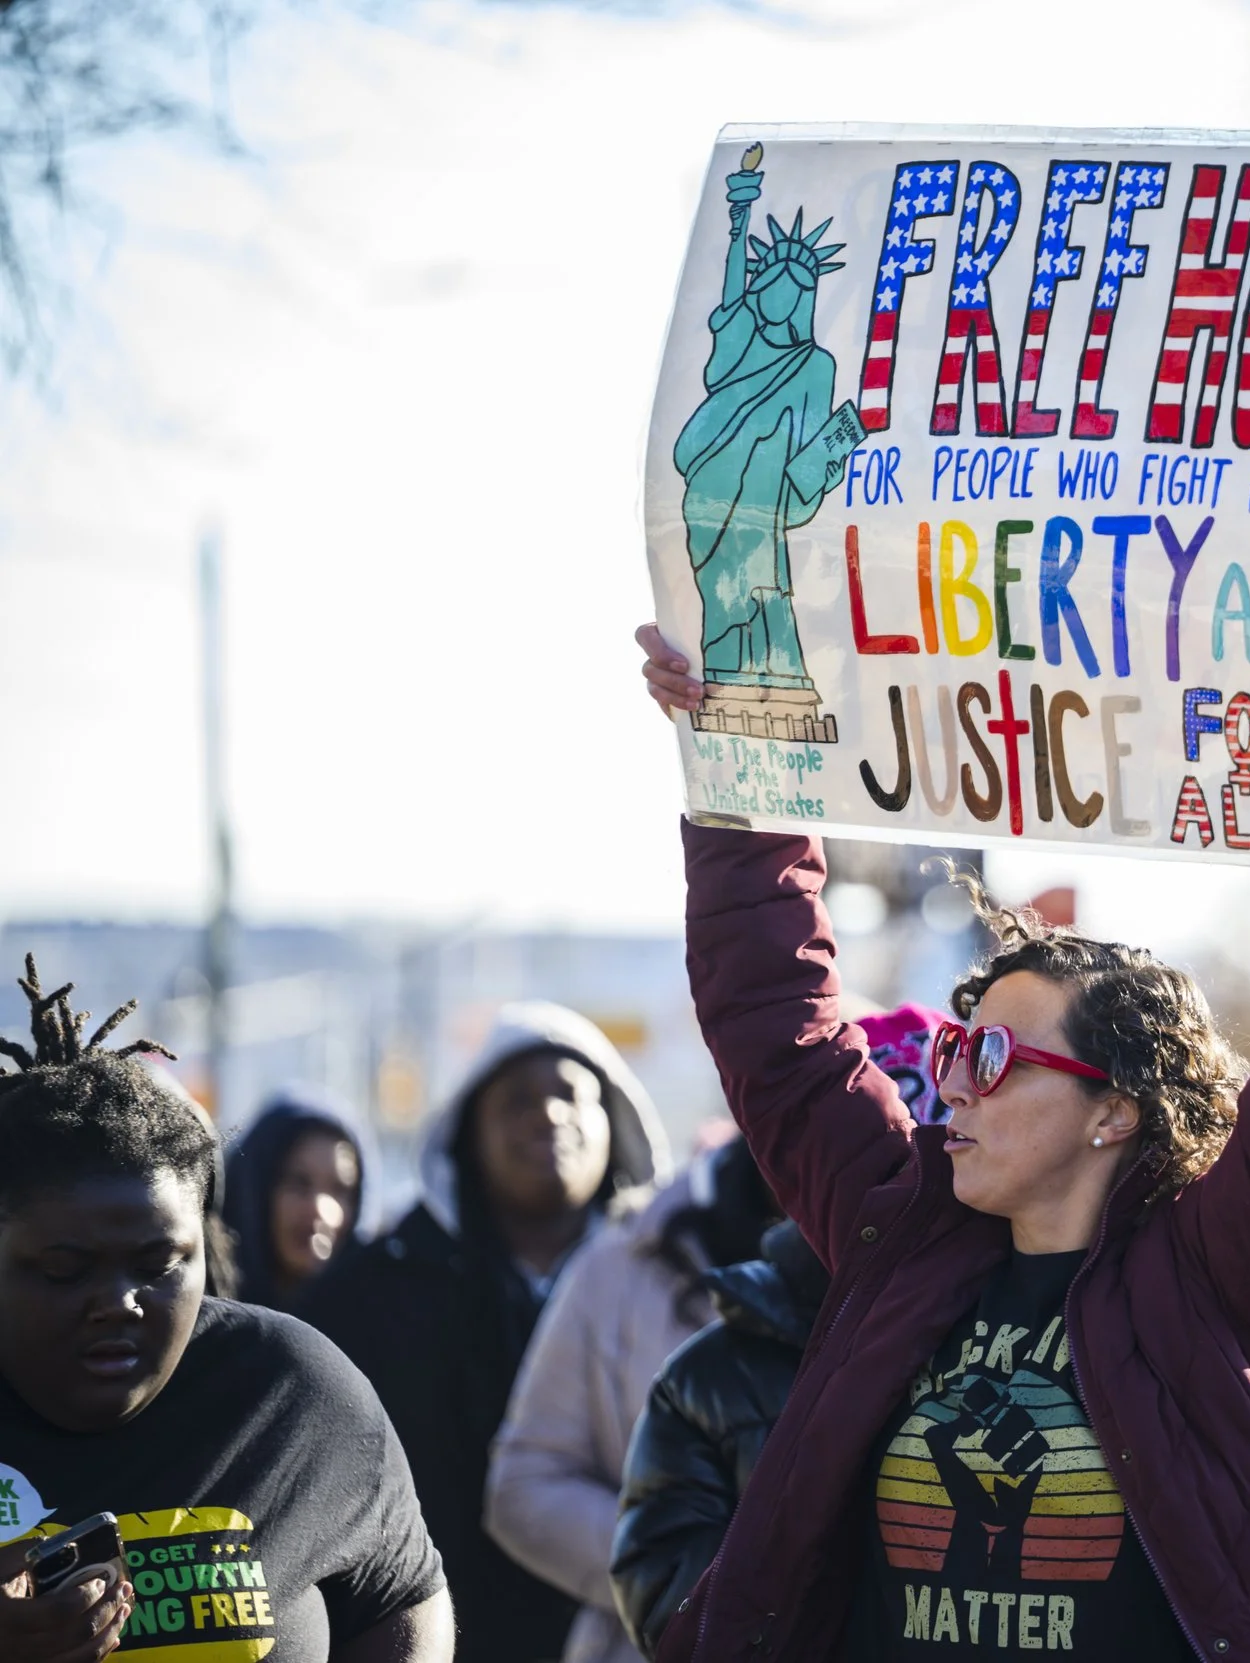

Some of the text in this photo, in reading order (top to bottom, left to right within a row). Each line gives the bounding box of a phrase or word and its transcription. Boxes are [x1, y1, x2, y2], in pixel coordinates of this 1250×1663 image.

[857, 159, 1171, 440] FREE
[846, 446, 904, 507] FOR
[932, 446, 1040, 502] PEOPLE
[1058, 450, 1118, 500] WHO
[1138, 454, 1232, 508] FIGHT
[845, 515, 1215, 682] LIBERTY
[693, 734, 823, 785] We The People
[736, 764, 779, 788] of the
[858, 669, 1152, 838] JUSTICE
[703, 782, 825, 818] United States
[133, 1560, 268, 1596] OURTH
[150, 1543, 197, 1564] GET
[190, 1591, 275, 1630] FREE
[903, 1584, 1075, 1650] MATTER
